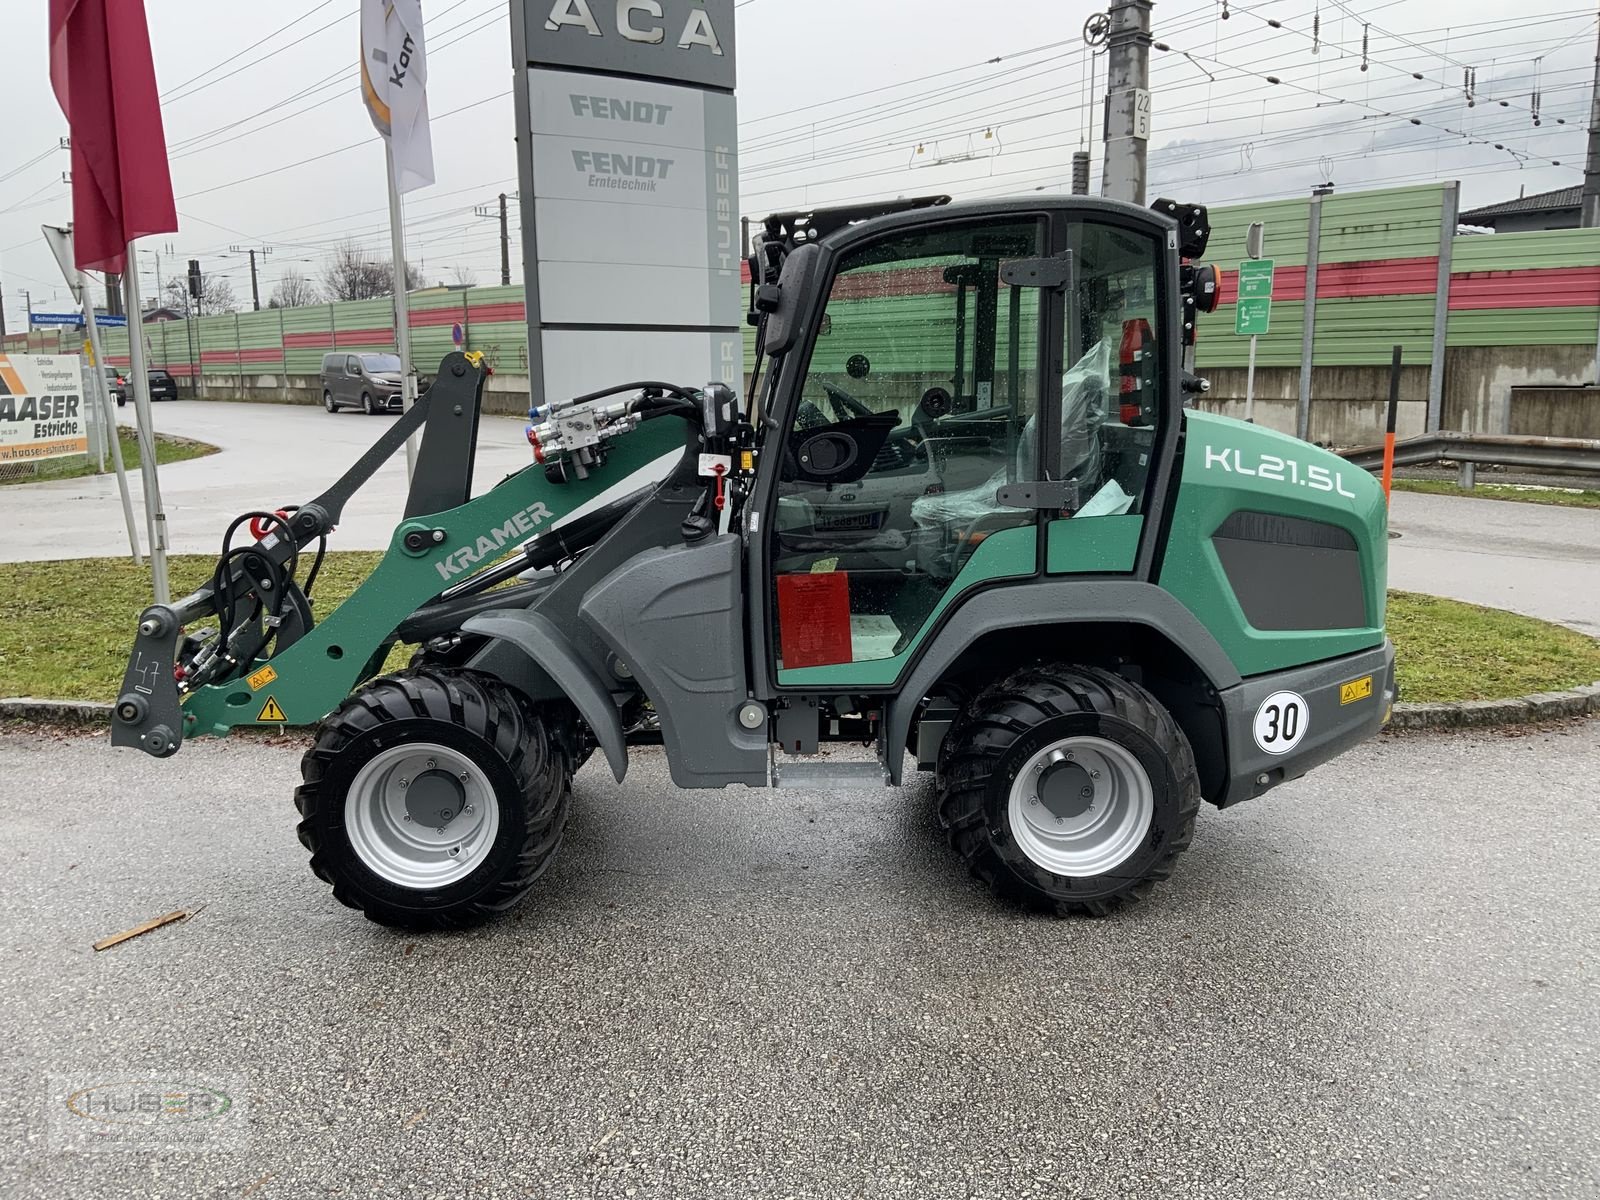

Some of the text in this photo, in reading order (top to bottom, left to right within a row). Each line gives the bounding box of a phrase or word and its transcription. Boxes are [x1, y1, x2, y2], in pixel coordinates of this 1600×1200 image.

[569, 94, 673, 126] FENDT
[1137, 93, 1149, 113] 22
[1140, 116, 1146, 134] 5
[571, 149, 675, 179] FENDT
[588, 174, 657, 193] Erntetechnik
[715, 145, 732, 276] HUBER
[34, 315, 80, 324] Schmelzerweg
[34, 420, 78, 438] Estriche
[1205, 445, 1356, 499] KL21.5L
[434, 501, 554, 581] KRAMER
[1263, 702, 1299, 744] 30
